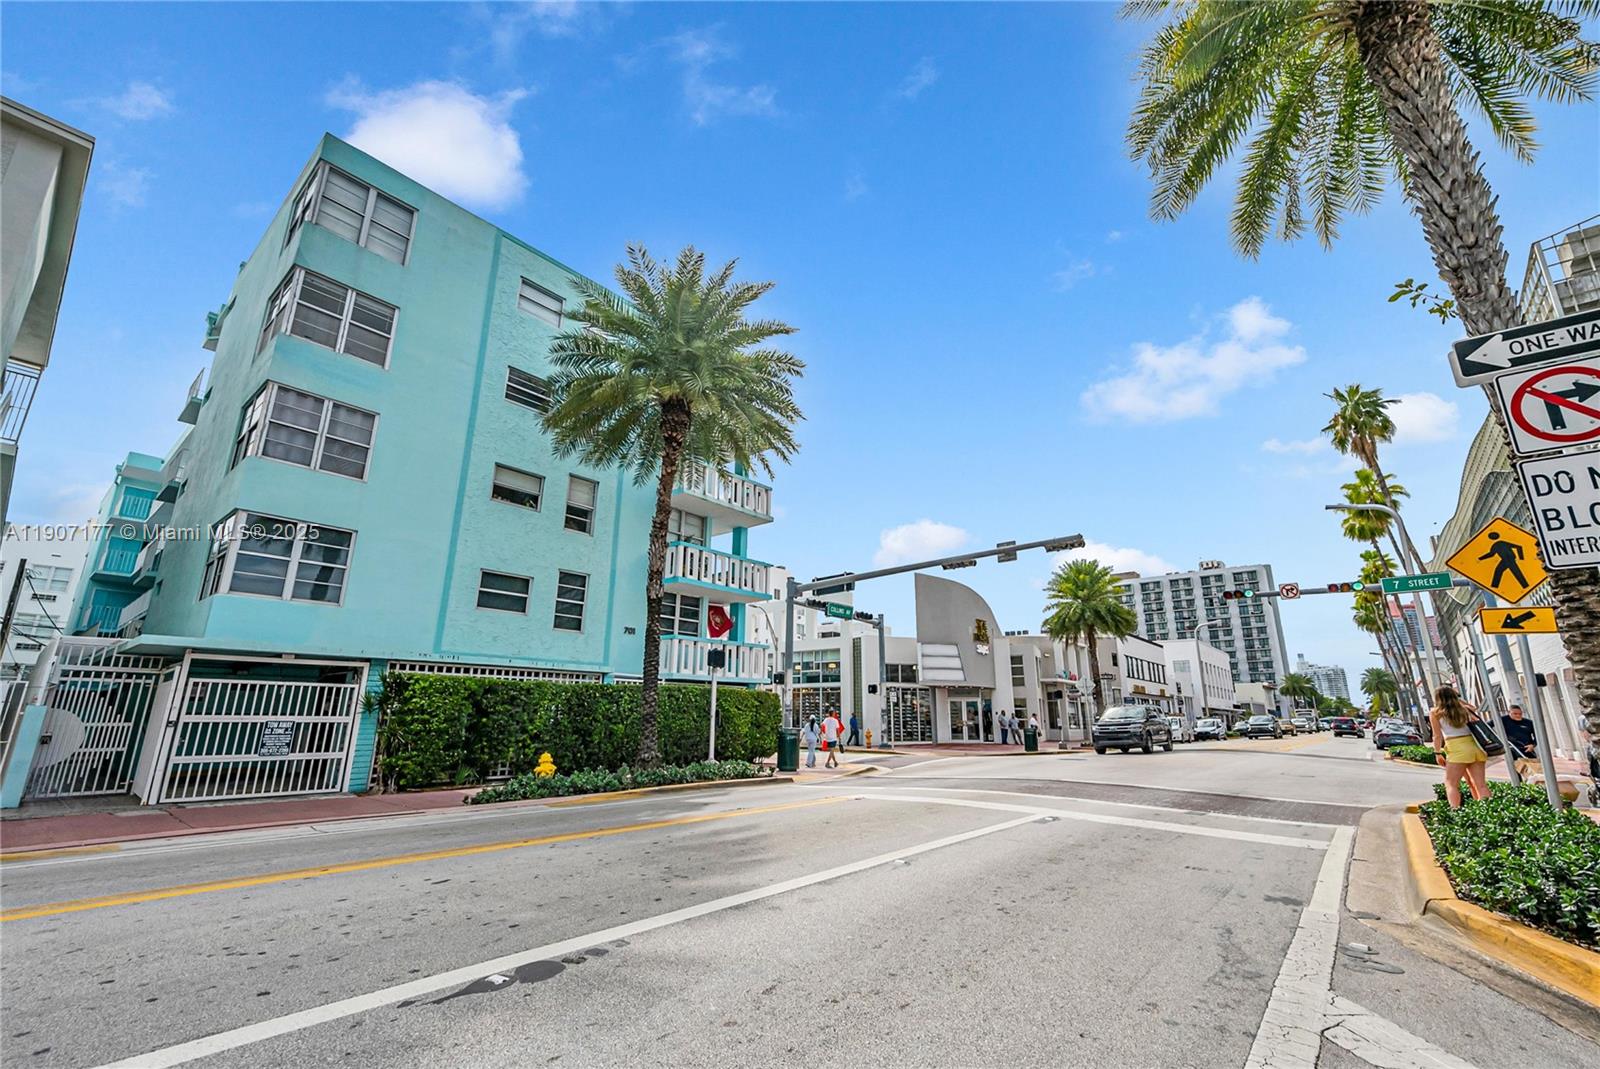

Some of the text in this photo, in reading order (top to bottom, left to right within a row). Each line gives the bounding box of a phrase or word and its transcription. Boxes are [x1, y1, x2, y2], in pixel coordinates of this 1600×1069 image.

[1509, 332, 1559, 355] ONE
[1531, 470, 1575, 497] DO
[1393, 578, 1439, 589] 7 STREET
[624, 626, 636, 635] 701
